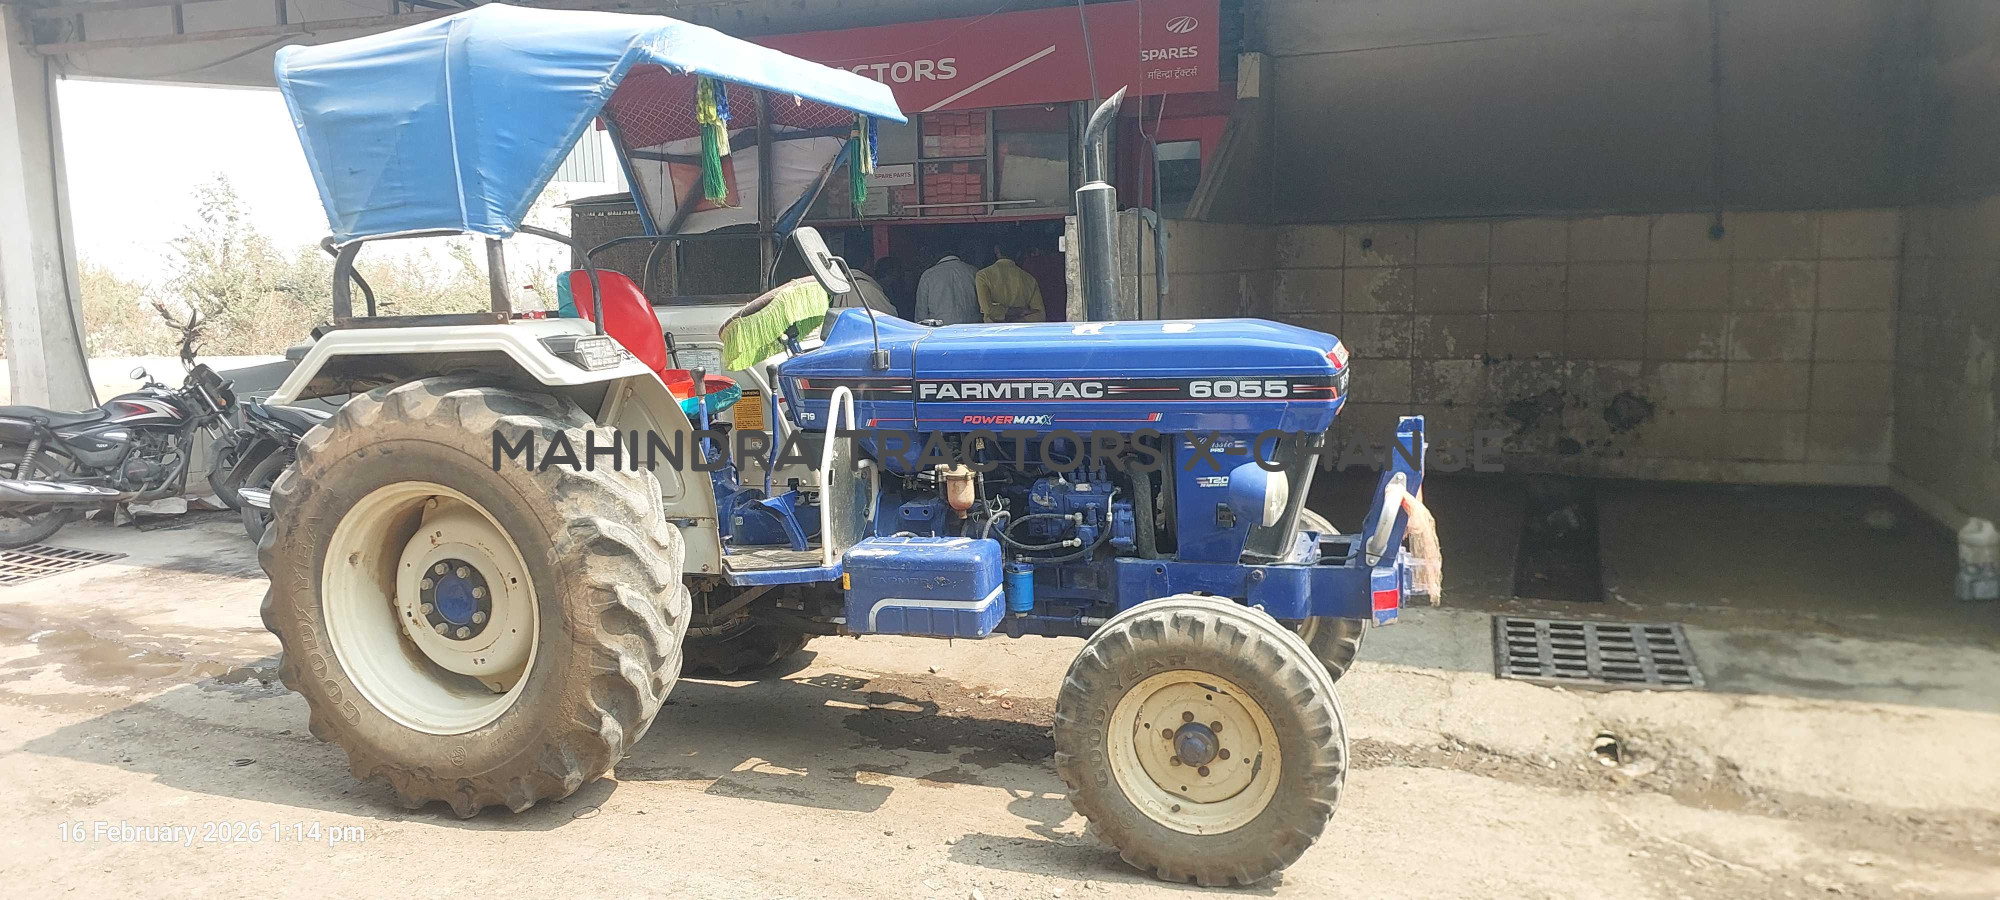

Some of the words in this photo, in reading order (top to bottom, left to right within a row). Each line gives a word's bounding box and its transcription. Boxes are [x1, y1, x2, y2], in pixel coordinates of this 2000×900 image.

[1141, 46, 1198, 61] SPARES
[919, 383, 1103, 399] FARMTRAC
[1189, 380, 1288, 398] 6055
[800, 413, 815, 421] F19
